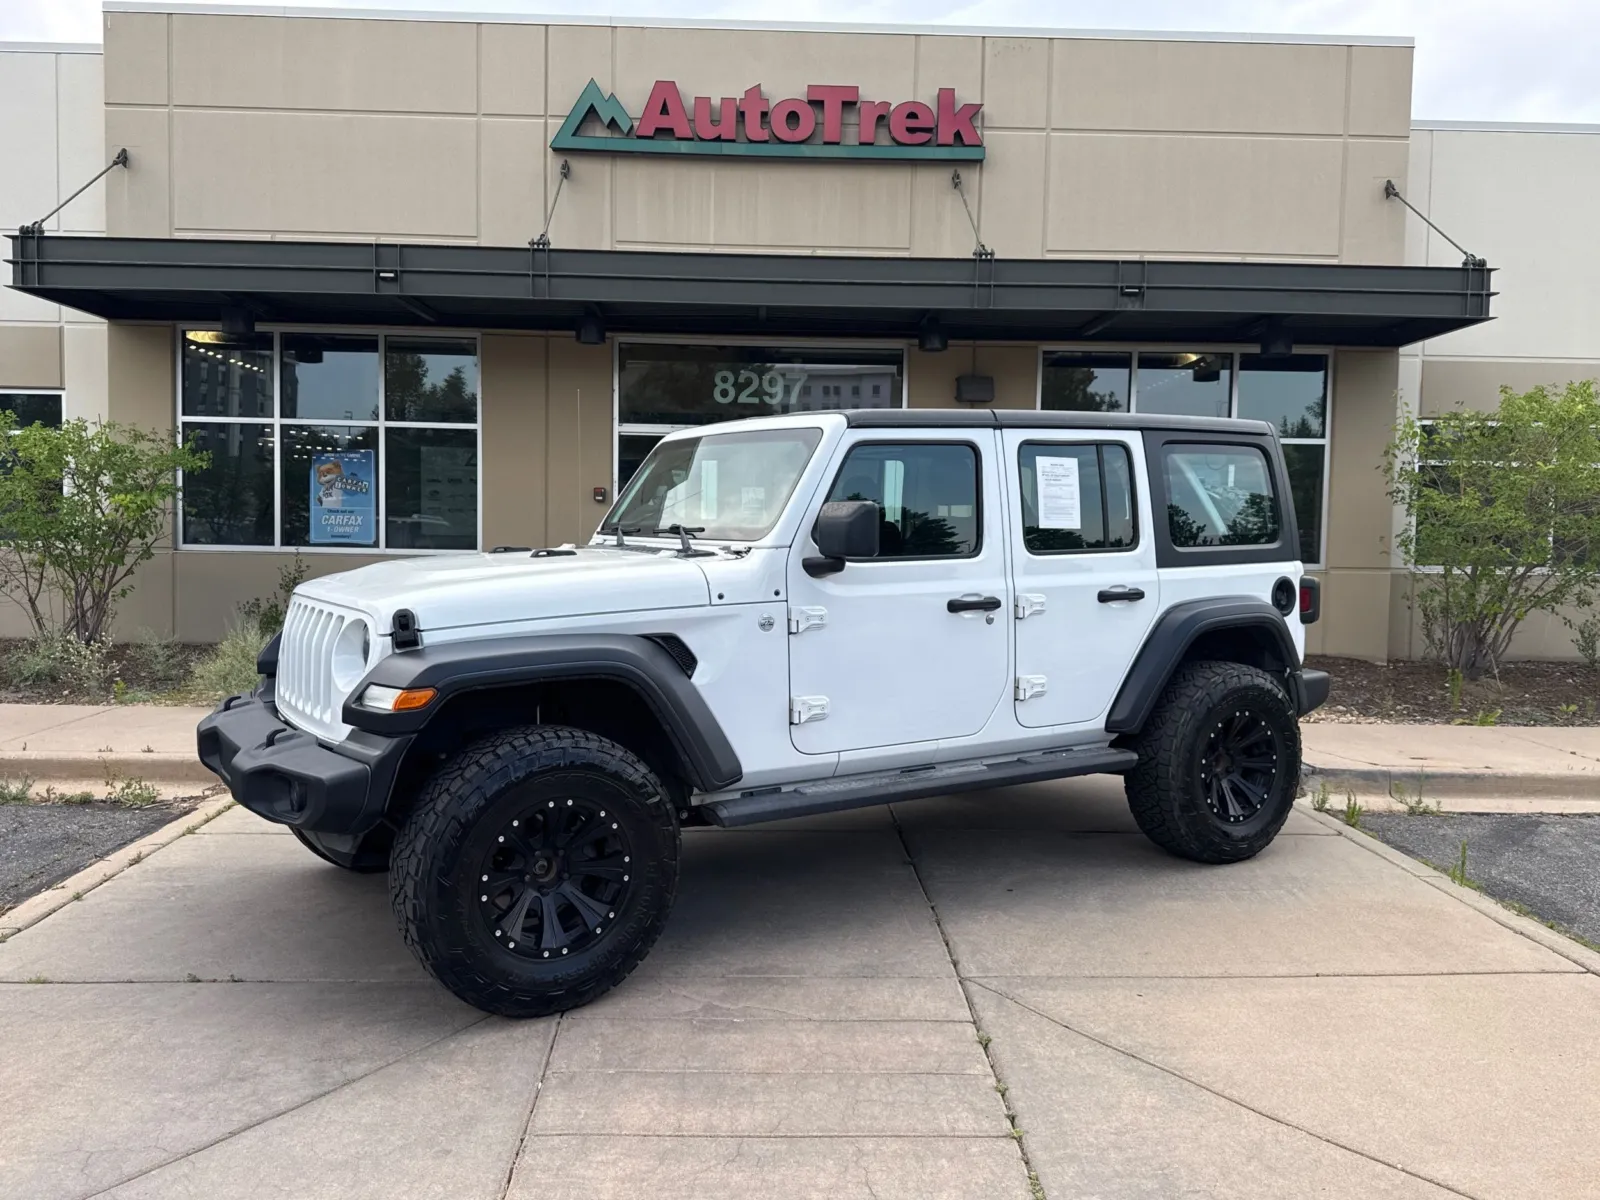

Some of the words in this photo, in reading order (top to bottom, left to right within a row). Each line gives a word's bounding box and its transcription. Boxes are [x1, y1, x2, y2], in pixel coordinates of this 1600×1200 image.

[635, 80, 984, 146] AutoTrek
[713, 370, 808, 405] 8297
[321, 515, 364, 526] CARFAX
